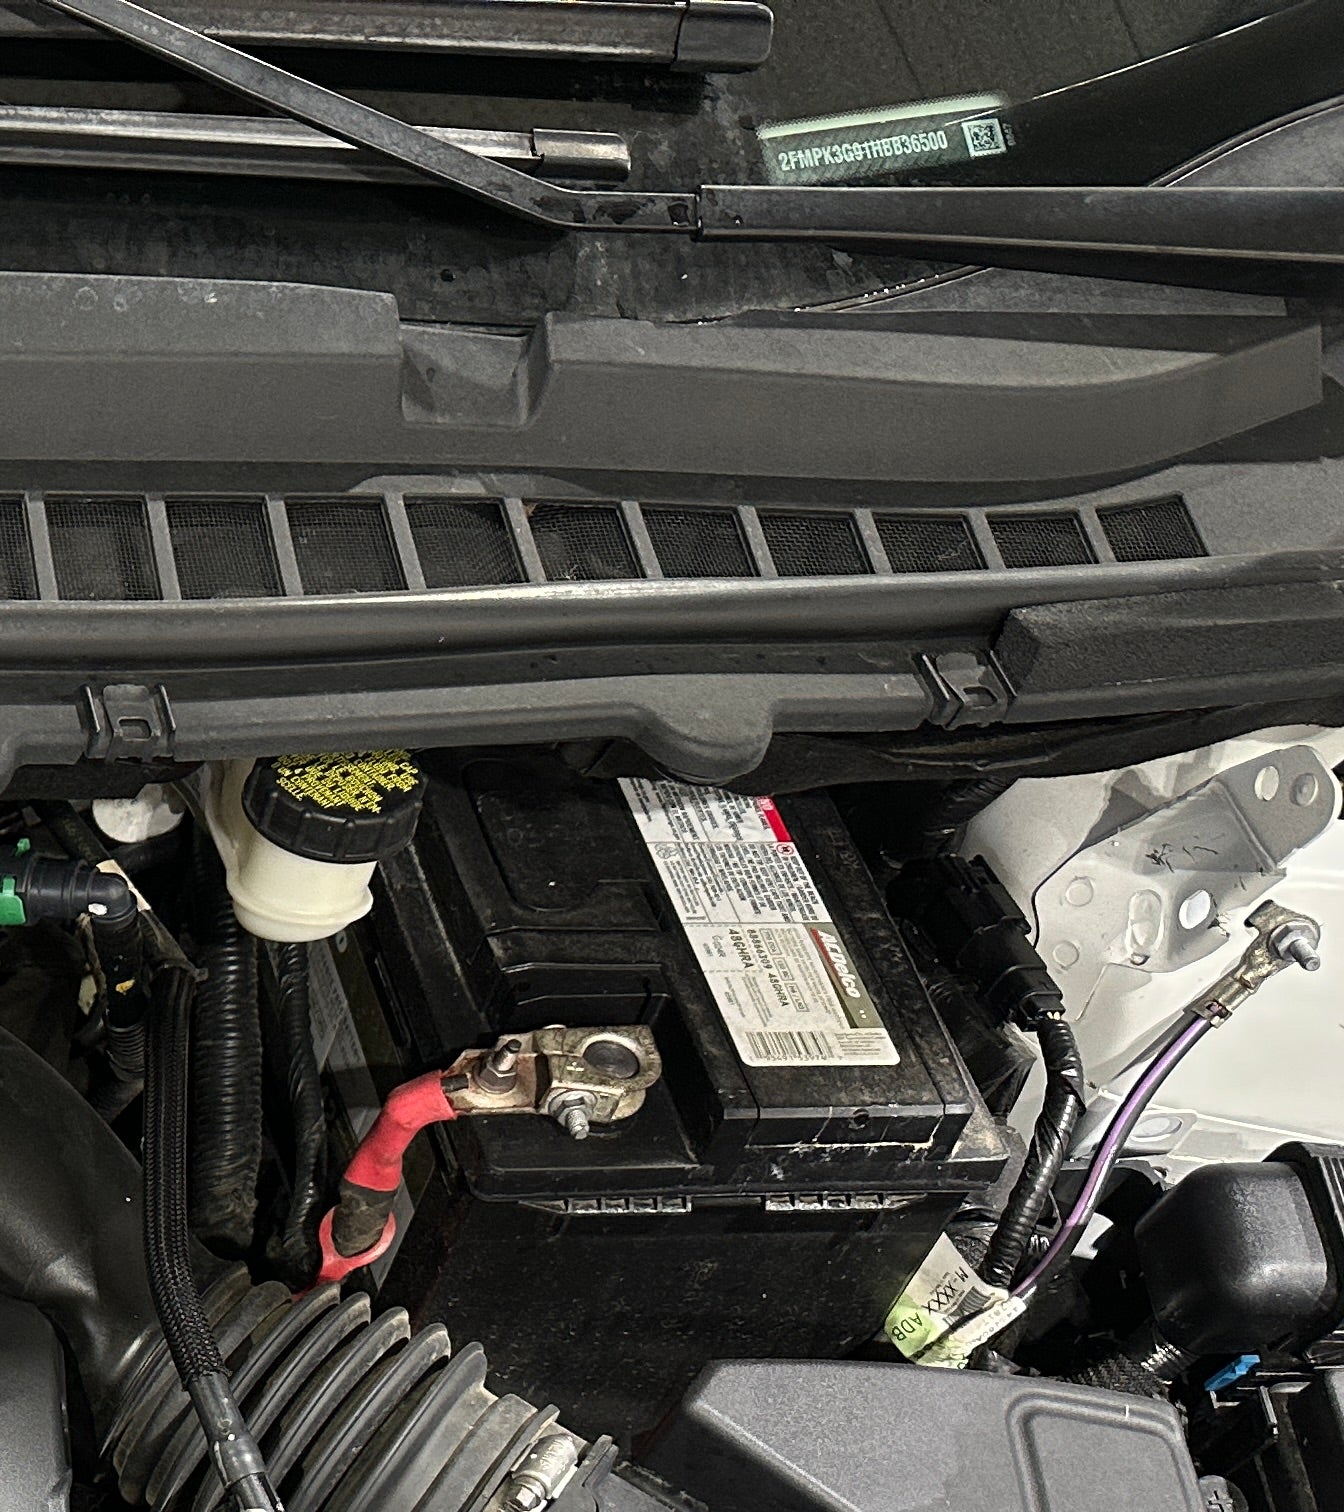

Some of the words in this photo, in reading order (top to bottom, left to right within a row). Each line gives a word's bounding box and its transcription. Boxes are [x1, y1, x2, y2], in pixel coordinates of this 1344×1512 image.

[778, 130, 948, 171] 2FMPK3G91HBB36500
[816, 929, 861, 999] ACDelco
[890, 1314, 924, 1341] ADB
